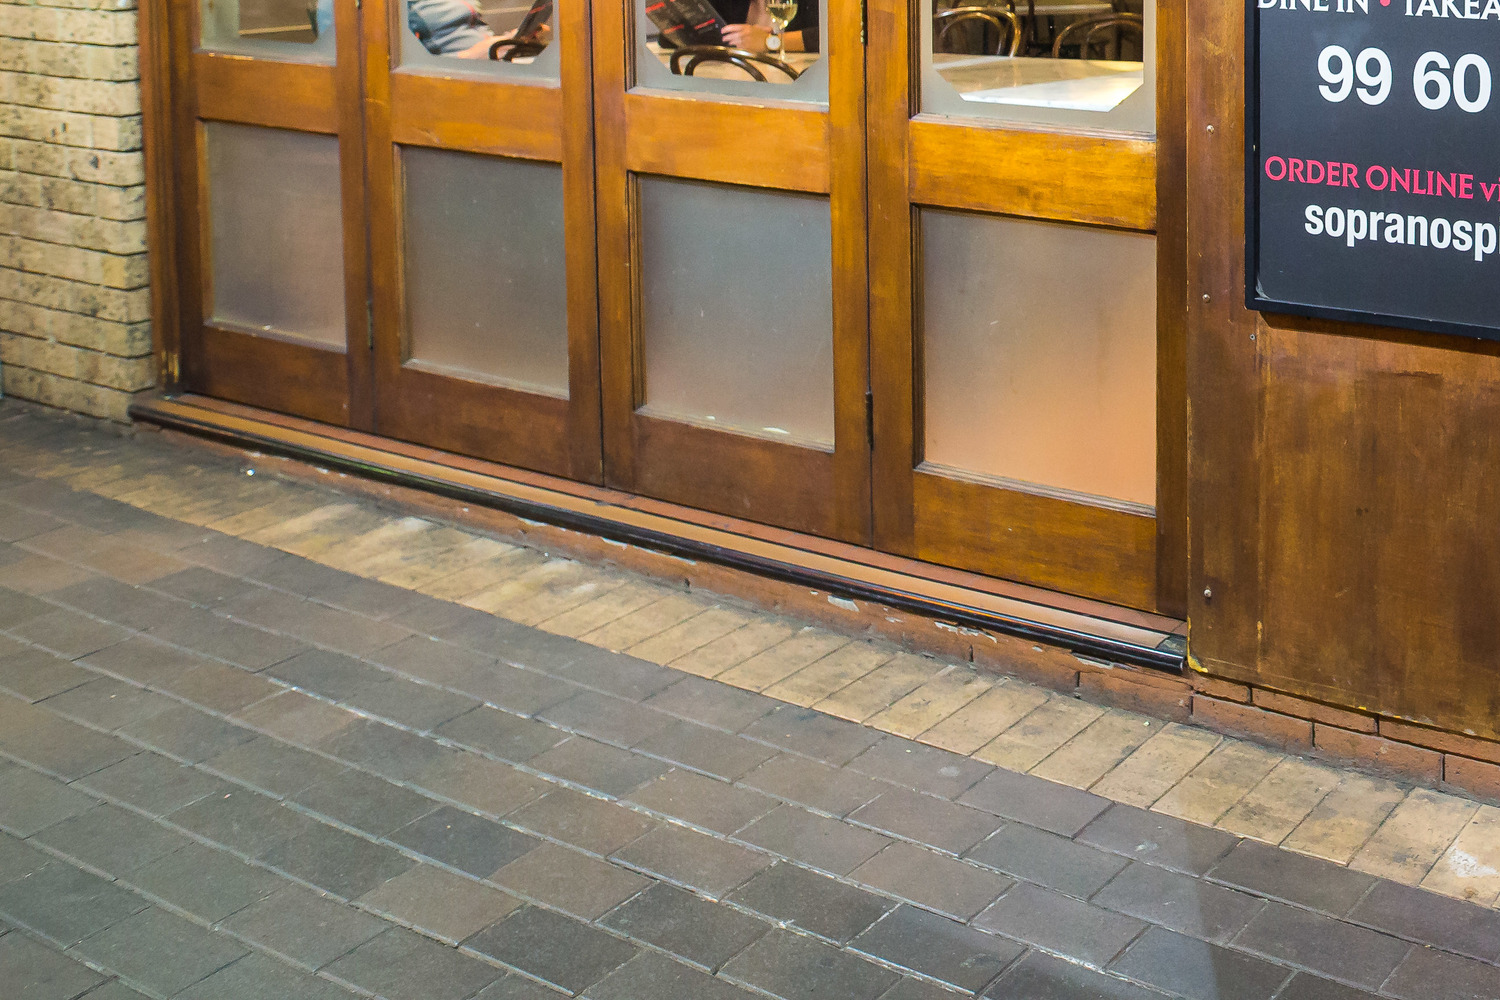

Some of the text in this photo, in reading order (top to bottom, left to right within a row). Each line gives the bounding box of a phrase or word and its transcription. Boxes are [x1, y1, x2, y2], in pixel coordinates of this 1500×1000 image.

[1317, 45, 1393, 106] 99
[1413, 51, 1492, 113] 60
[1264, 155, 1359, 189] ORDER
[1365, 164, 1474, 199] ONLINE
